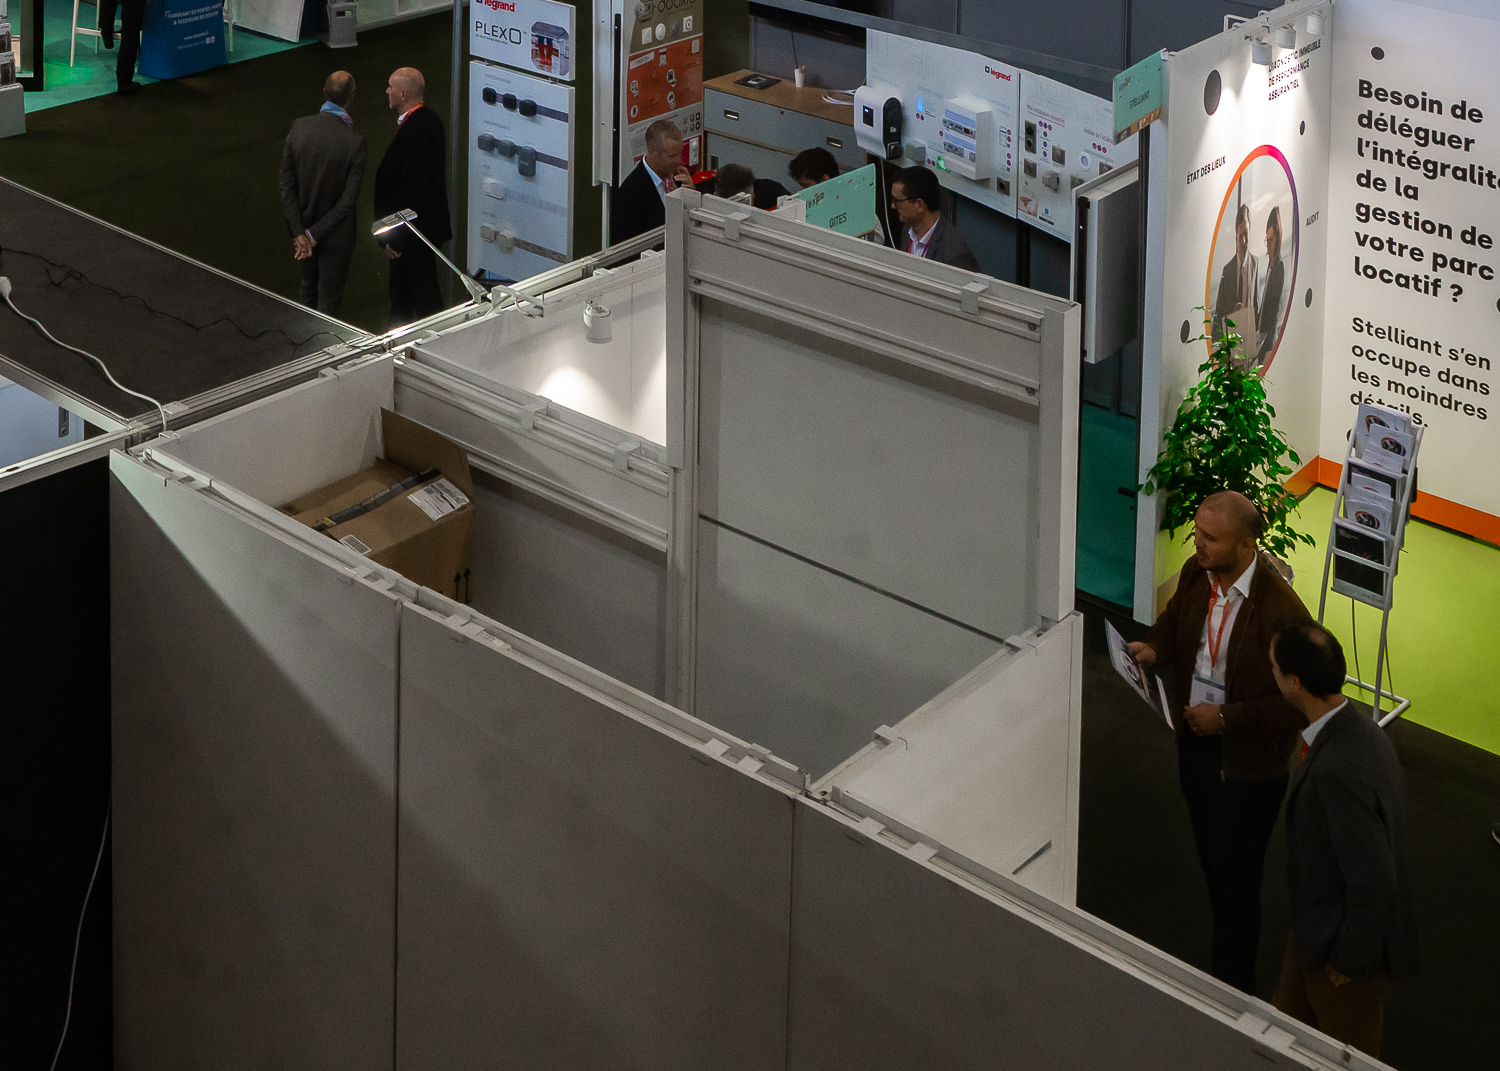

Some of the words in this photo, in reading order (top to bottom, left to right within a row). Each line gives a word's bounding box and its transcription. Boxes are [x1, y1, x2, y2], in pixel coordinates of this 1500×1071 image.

[475, 20, 522, 45] PLEXO
[990, 67, 1011, 81] legrand
[1129, 90, 1150, 110] STELLIANT
[1358, 79, 1443, 115] Besoin
[1450, 100, 1484, 124] de
[1357, 109, 1476, 153] déléguer
[1186, 170, 1199, 185] ÉTAT
[1200, 163, 1211, 178] DES
[1211, 155, 1226, 172] LIEUX
[1355, 169, 1388, 192] de
[1395, 176, 1419, 201] la
[1357, 137, 1500, 190] l'intégralit
[829, 212, 847, 228] GITES
[1306, 211, 1320, 227] AUDIT
[1355, 201, 1453, 240] gestion
[1460, 225, 1494, 250] de
[1354, 231, 1425, 263] votre
[1431, 251, 1495, 281] parc
[1354, 256, 1442, 298] locatif
[1351, 316, 1442, 357] Stelliant
[1448, 347, 1491, 371] s'en
[1351, 345, 1431, 377] occupe
[1437, 368, 1490, 396] dans
[1351, 364, 1381, 388] les
[1387, 379, 1488, 421] moindres
